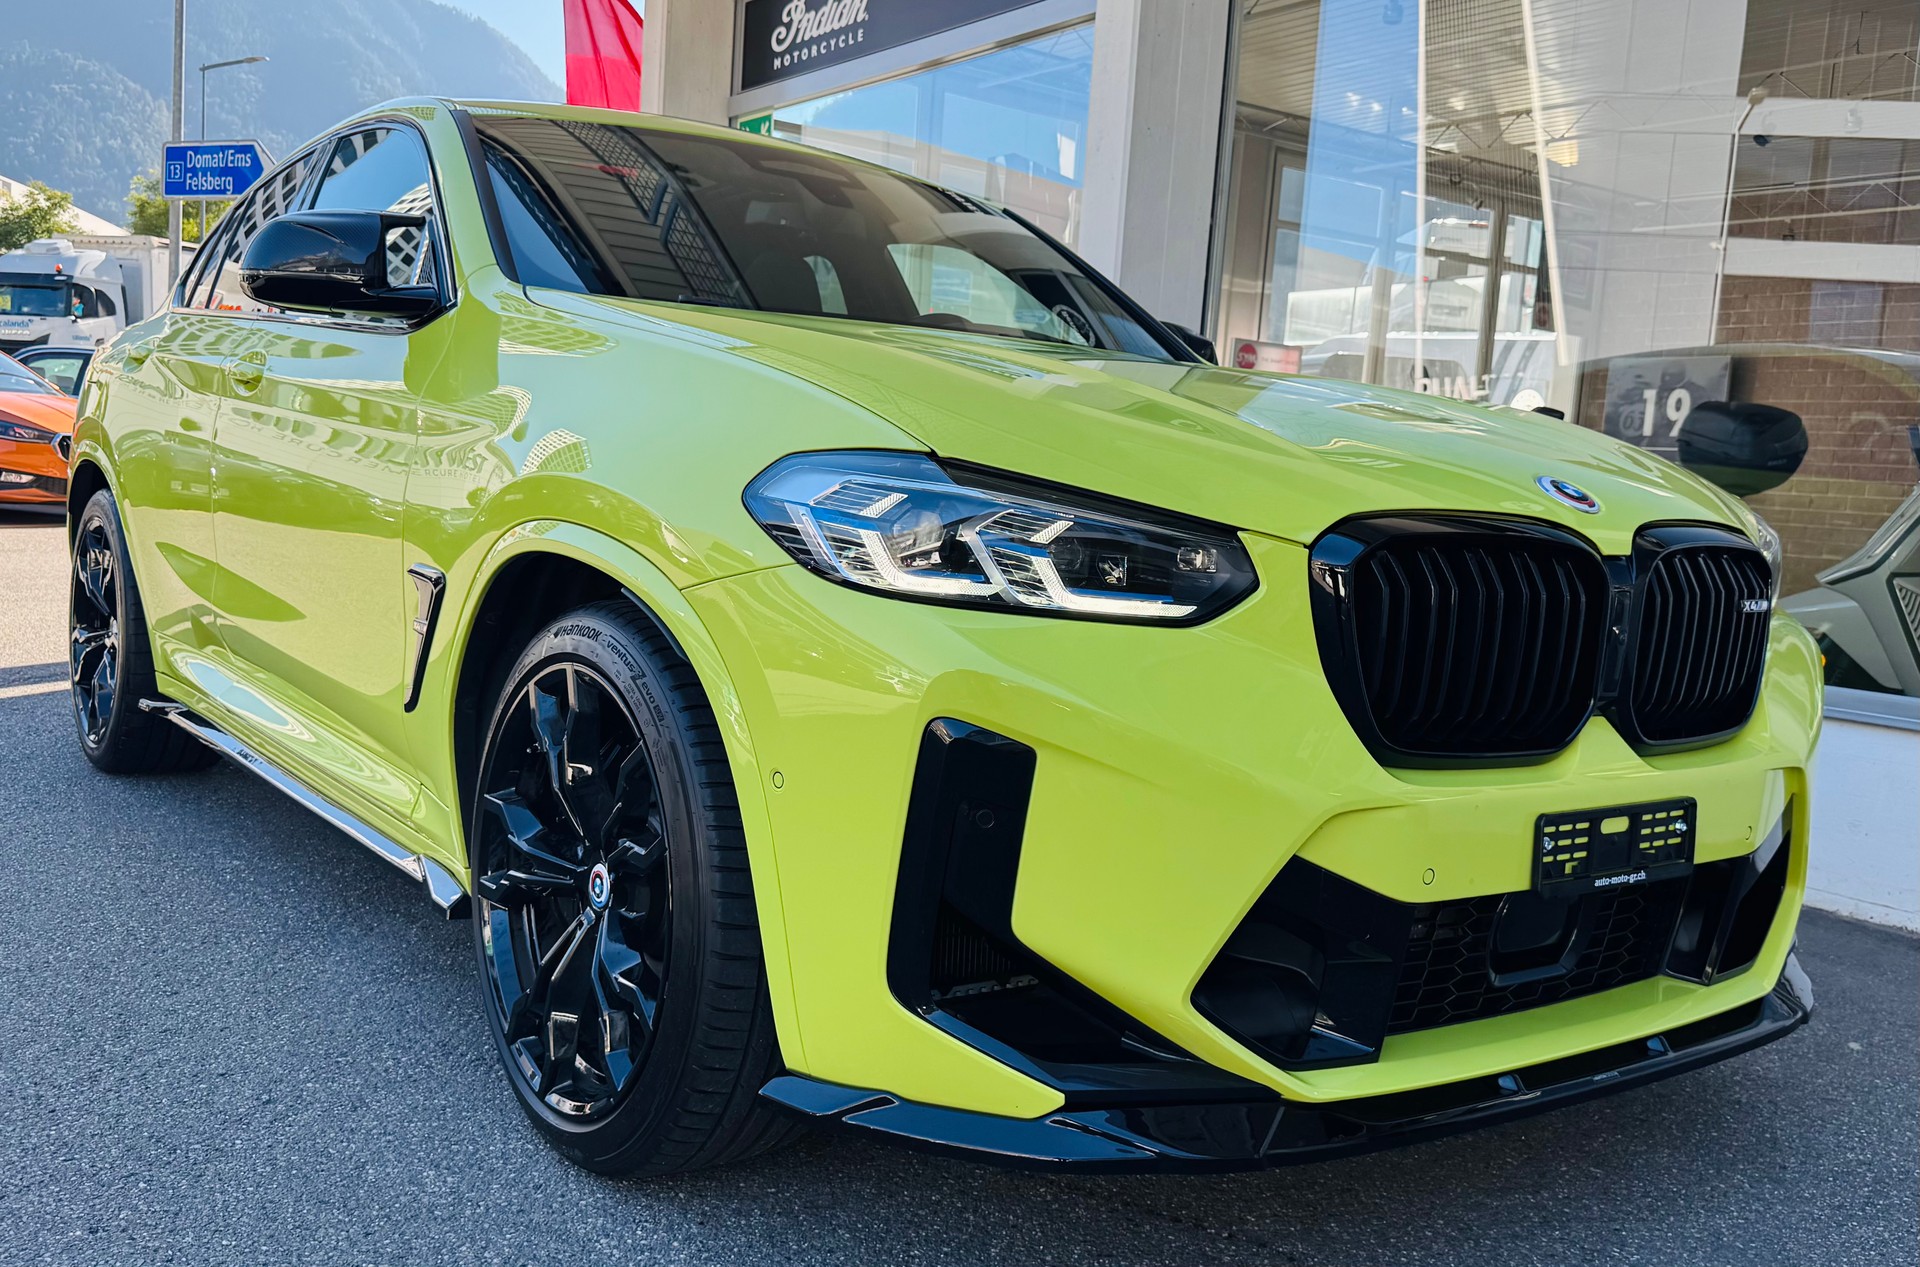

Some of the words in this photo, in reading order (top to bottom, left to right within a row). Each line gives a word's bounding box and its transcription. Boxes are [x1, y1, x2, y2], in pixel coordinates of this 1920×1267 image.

[771, 0, 868, 53] Indian
[773, 28, 864, 70] MOTORCYCLE
[186, 149, 252, 168] Domat/Ems
[169, 164, 181, 178] 13
[185, 171, 233, 194] Felsberg
[1594, 870, 1646, 887] auto-moto-gr.ch
